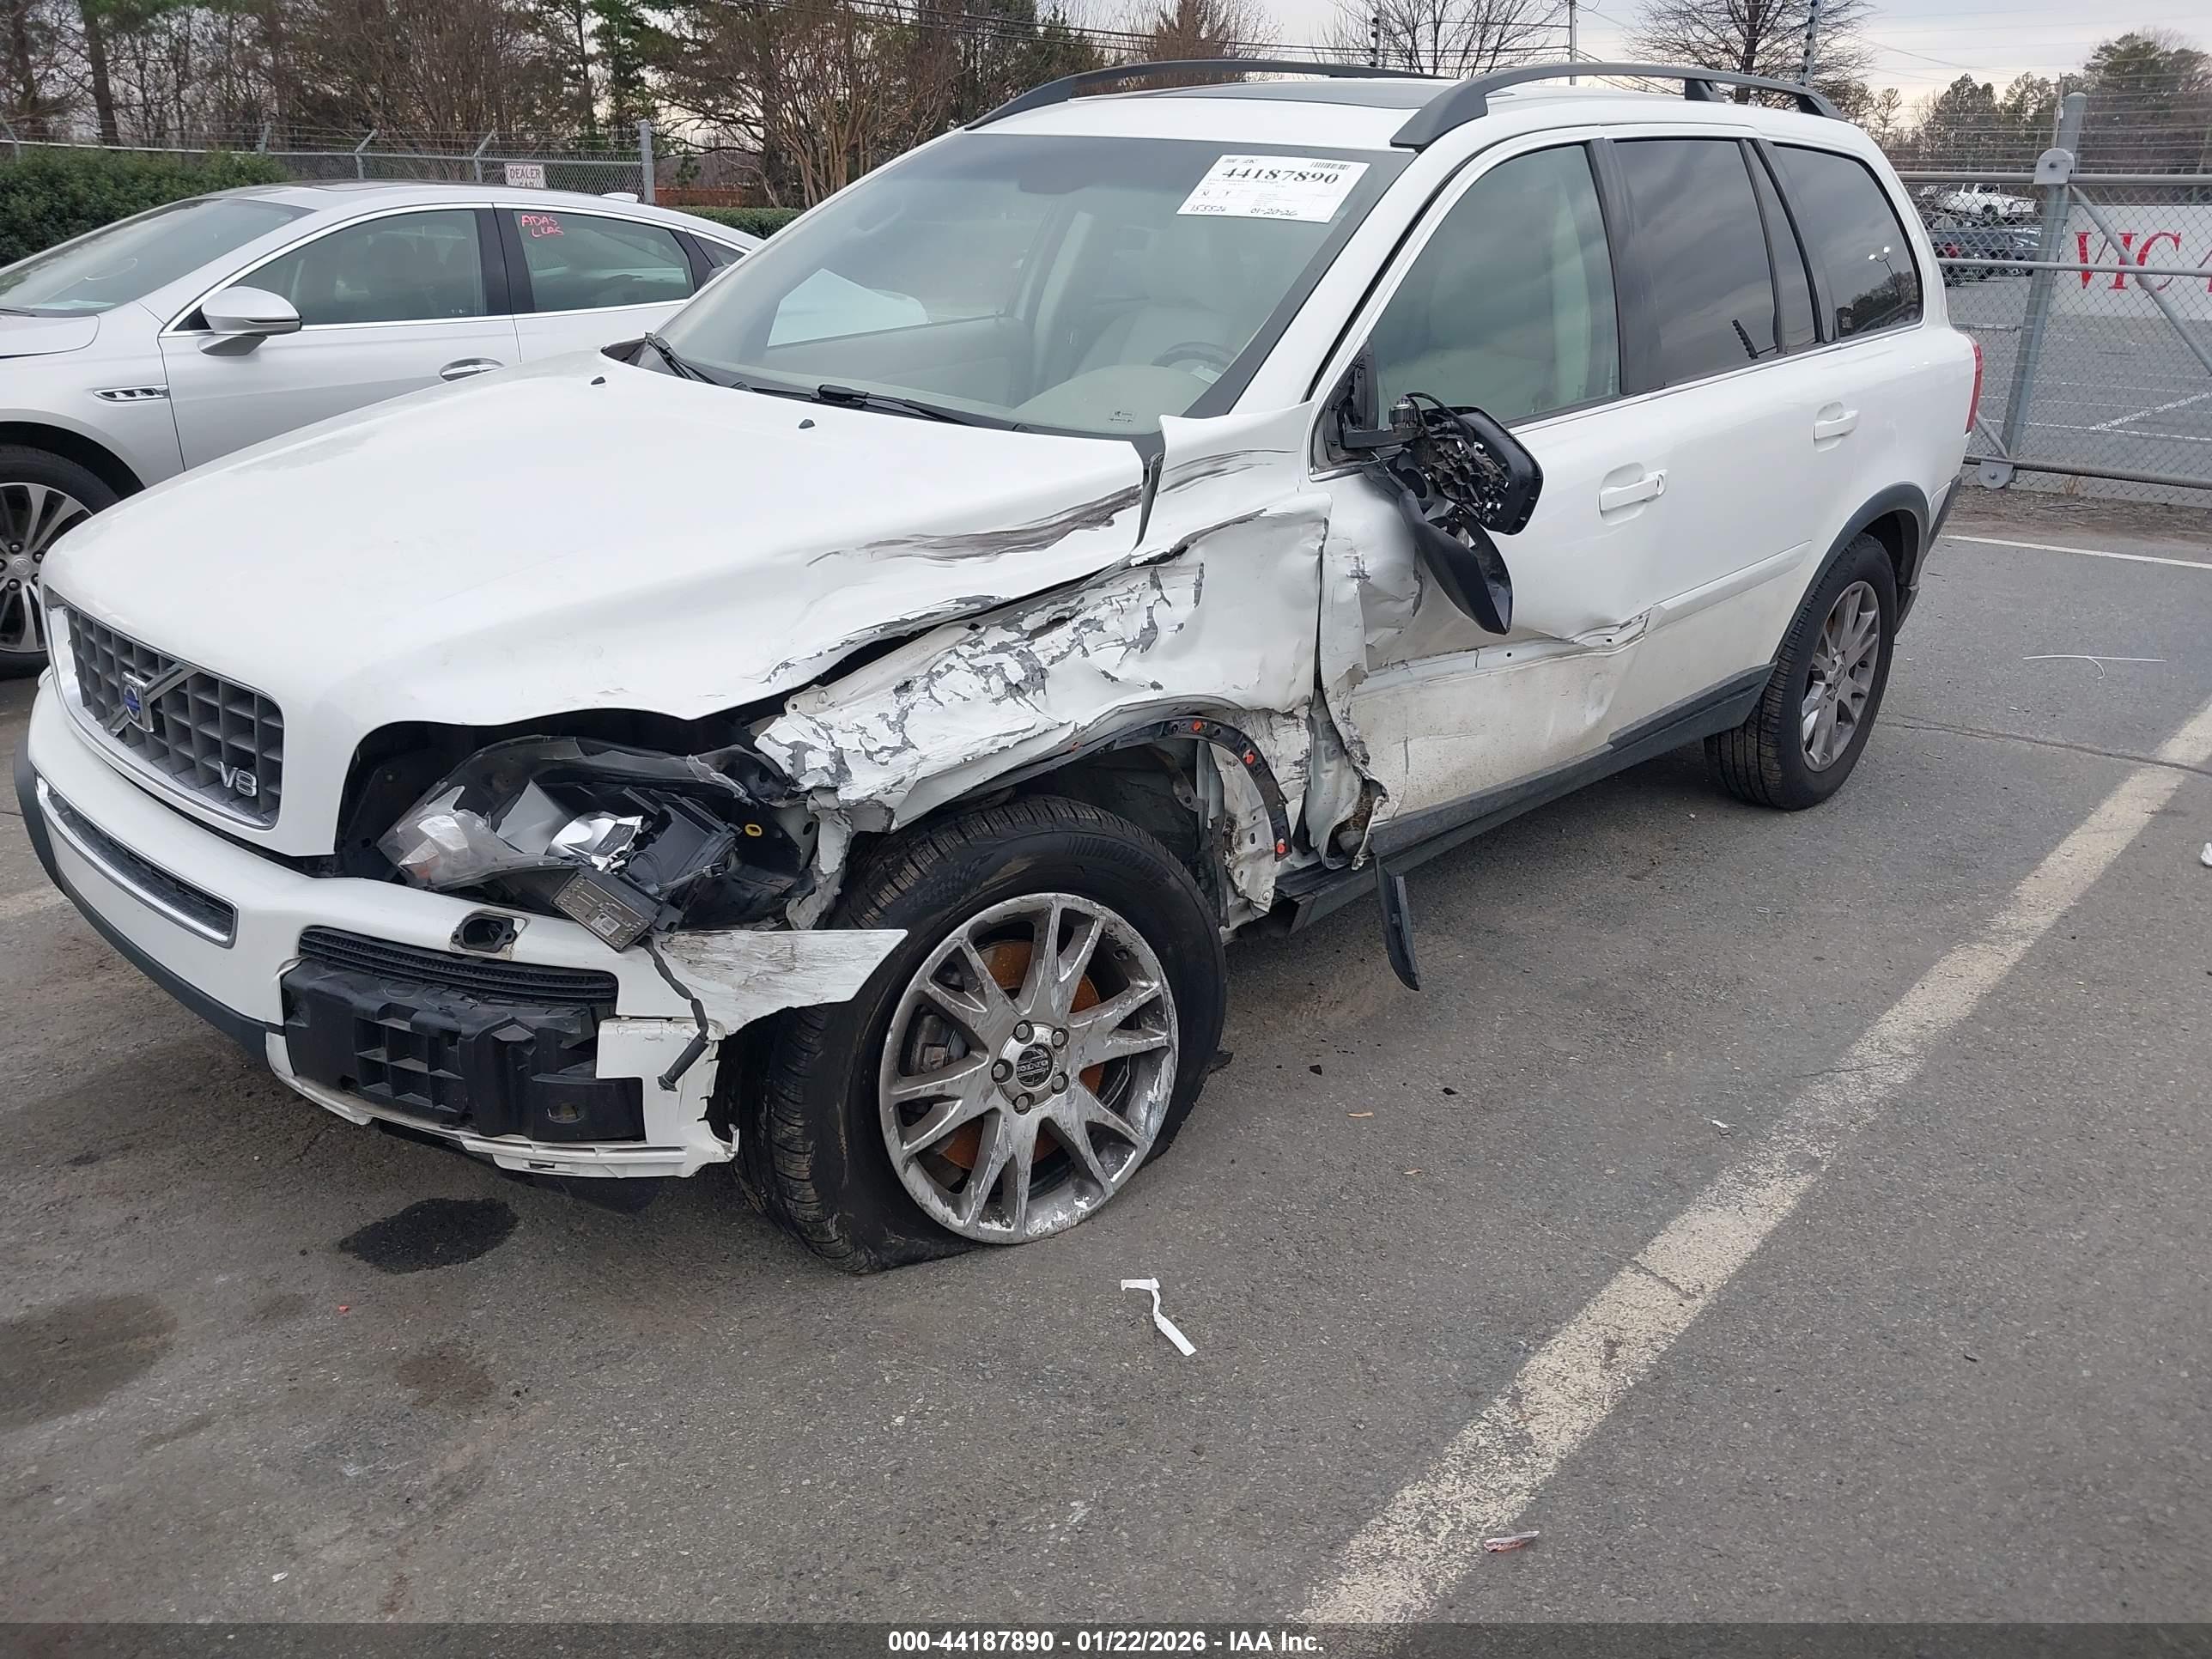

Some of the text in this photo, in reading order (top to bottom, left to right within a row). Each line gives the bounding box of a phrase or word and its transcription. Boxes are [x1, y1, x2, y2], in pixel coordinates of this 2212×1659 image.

[509, 168, 541, 179] DEALER
[1222, 167, 1340, 185] 44187890
[521, 215, 557, 227] ADAS
[218, 761, 258, 797] V8
